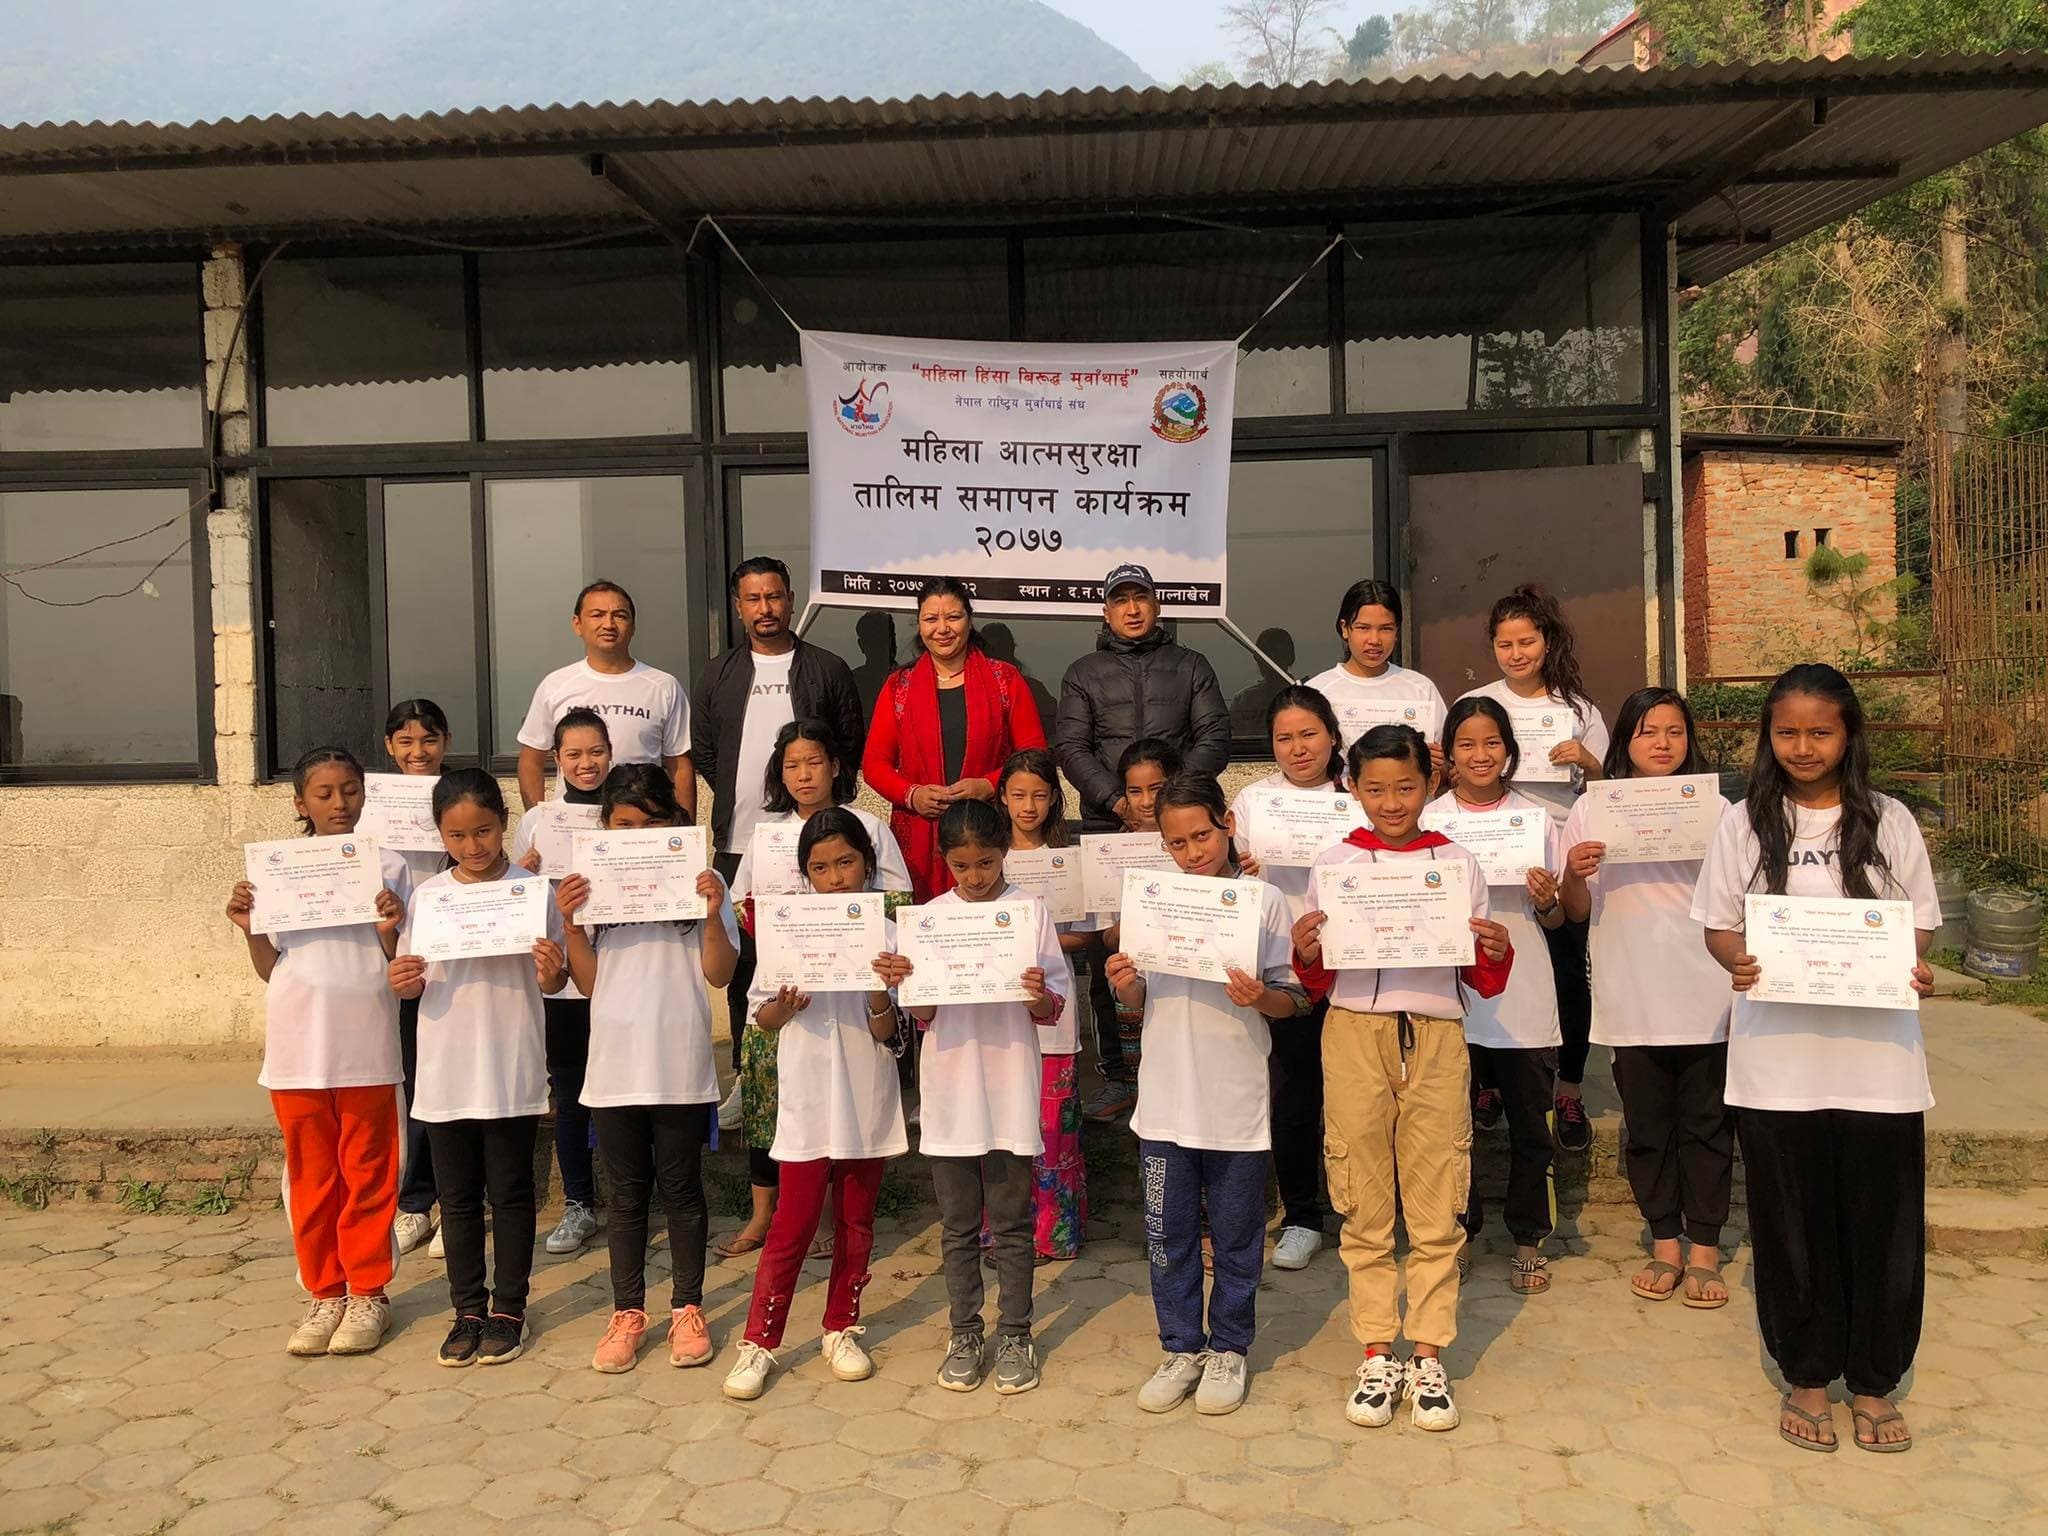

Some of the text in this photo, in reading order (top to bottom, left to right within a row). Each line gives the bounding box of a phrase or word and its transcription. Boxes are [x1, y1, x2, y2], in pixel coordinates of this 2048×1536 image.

[842, 360, 887, 372] आयोजक
[975, 366, 1010, 384] हिंसा
[1159, 367, 1209, 380] सहयोगार्थ
[955, 395, 982, 407] नेपाल
[901, 430, 1141, 475] महिला आत्मसुरक्षा
[853, 475, 1191, 518] तालिम समापन कार्यक्रम
[975, 526, 1062, 557] २०७७
[843, 574, 871, 591] मिति
[1018, 585, 1051, 598] स्थान
[1068, 586, 1105, 600] द.न.प
[567, 704, 650, 719] MAYTHAI
